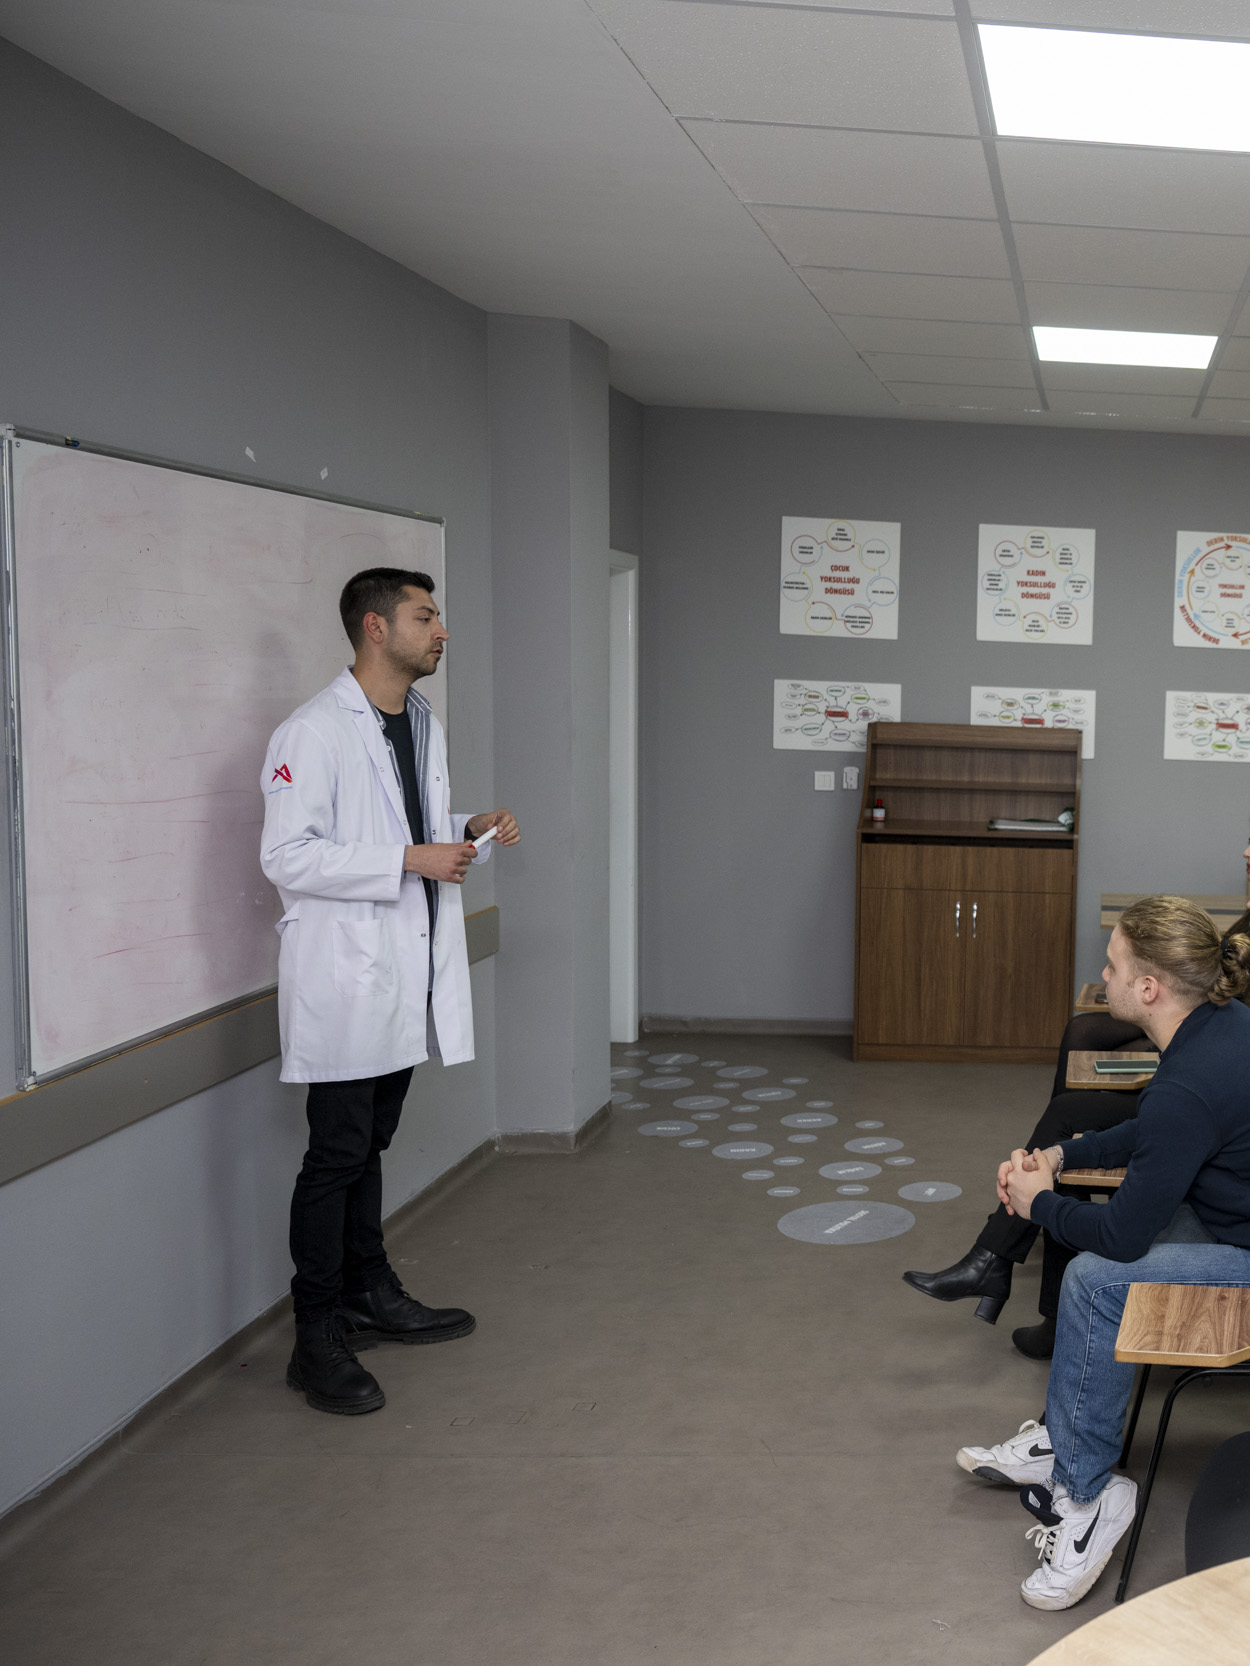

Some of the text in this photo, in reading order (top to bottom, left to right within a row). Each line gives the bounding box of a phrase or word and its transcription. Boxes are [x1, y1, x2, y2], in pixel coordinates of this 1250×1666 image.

[830, 564, 850, 573] ÇOCUK
[820, 575, 860, 584] YOKSULLUĞU
[1016, 580, 1056, 589] YOKSULLUĞU
[824, 587, 855, 596] DÖNGÜSÜ
[1020, 592, 1051, 600] DÖNGÜSÜ
